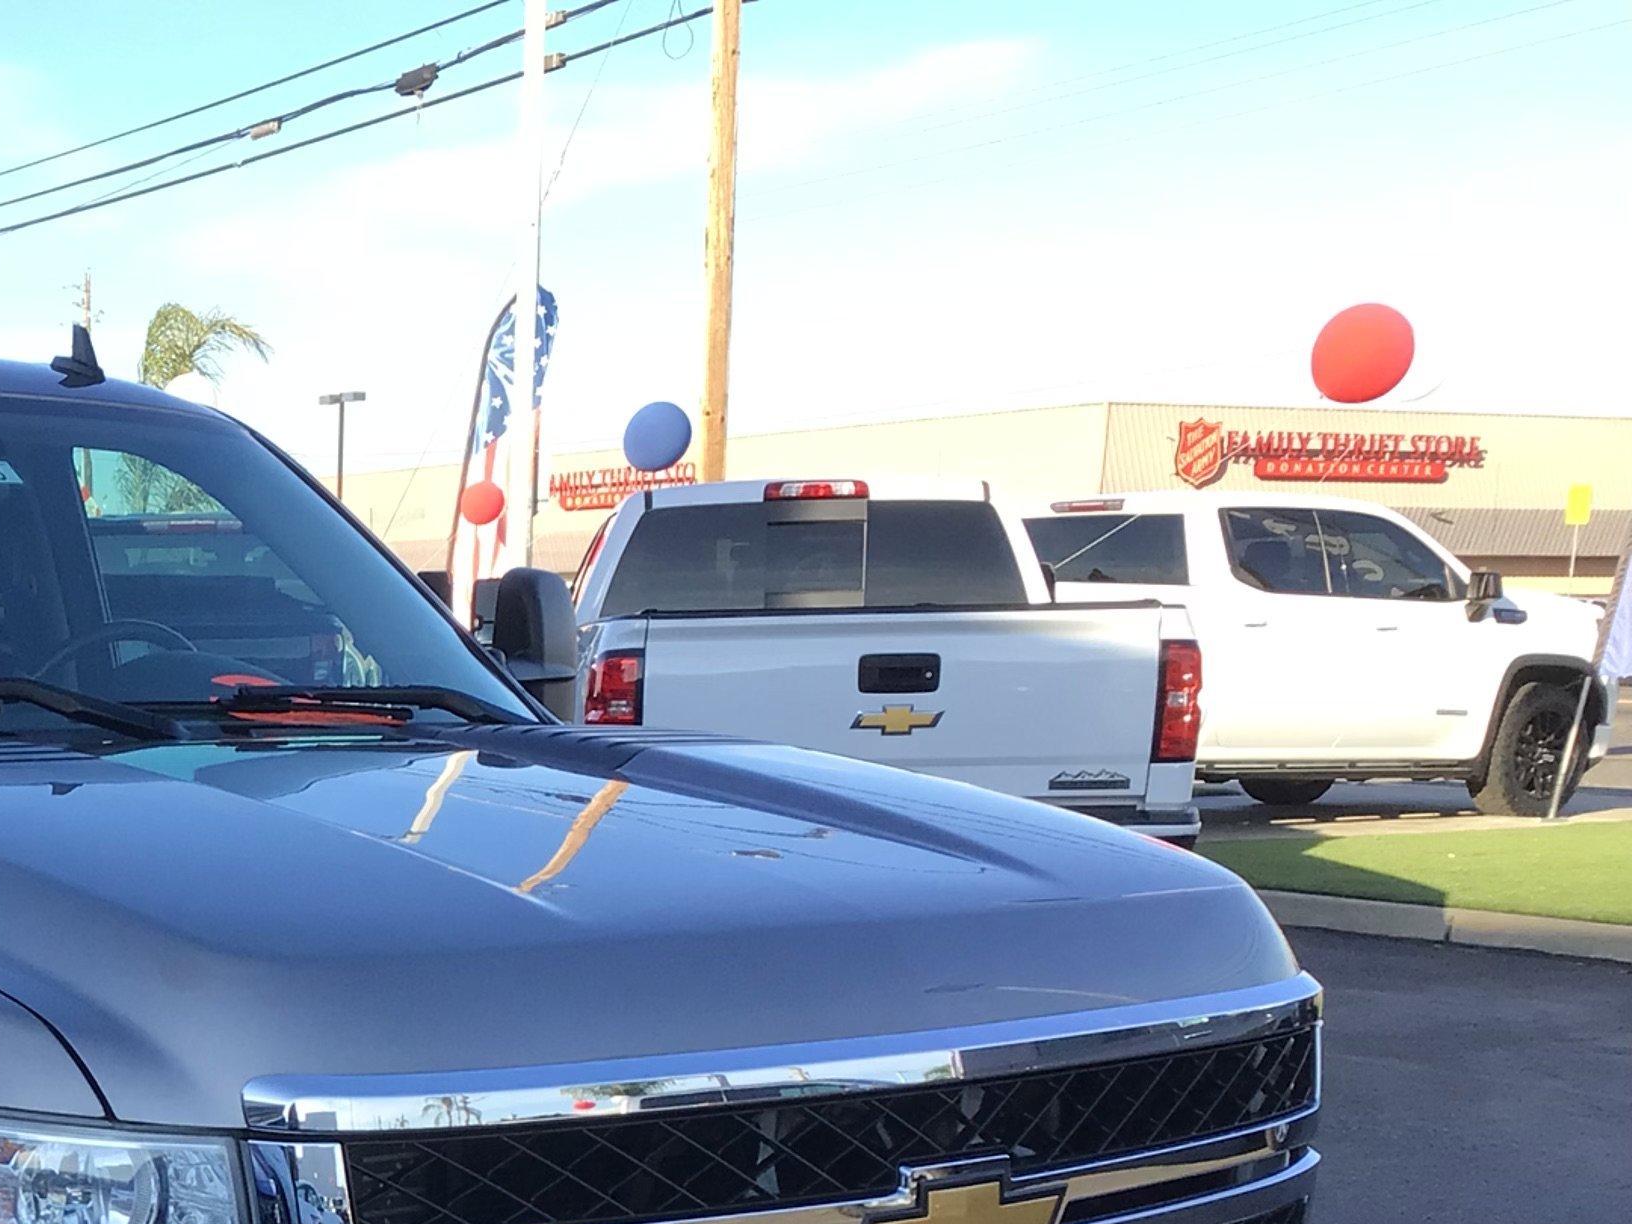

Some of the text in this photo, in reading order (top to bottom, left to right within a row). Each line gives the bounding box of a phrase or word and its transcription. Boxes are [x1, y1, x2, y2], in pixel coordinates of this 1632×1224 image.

[1226, 430, 1481, 461] FAMILY THRIFT STORE
[1266, 461, 1433, 476] DONATION CENTER
